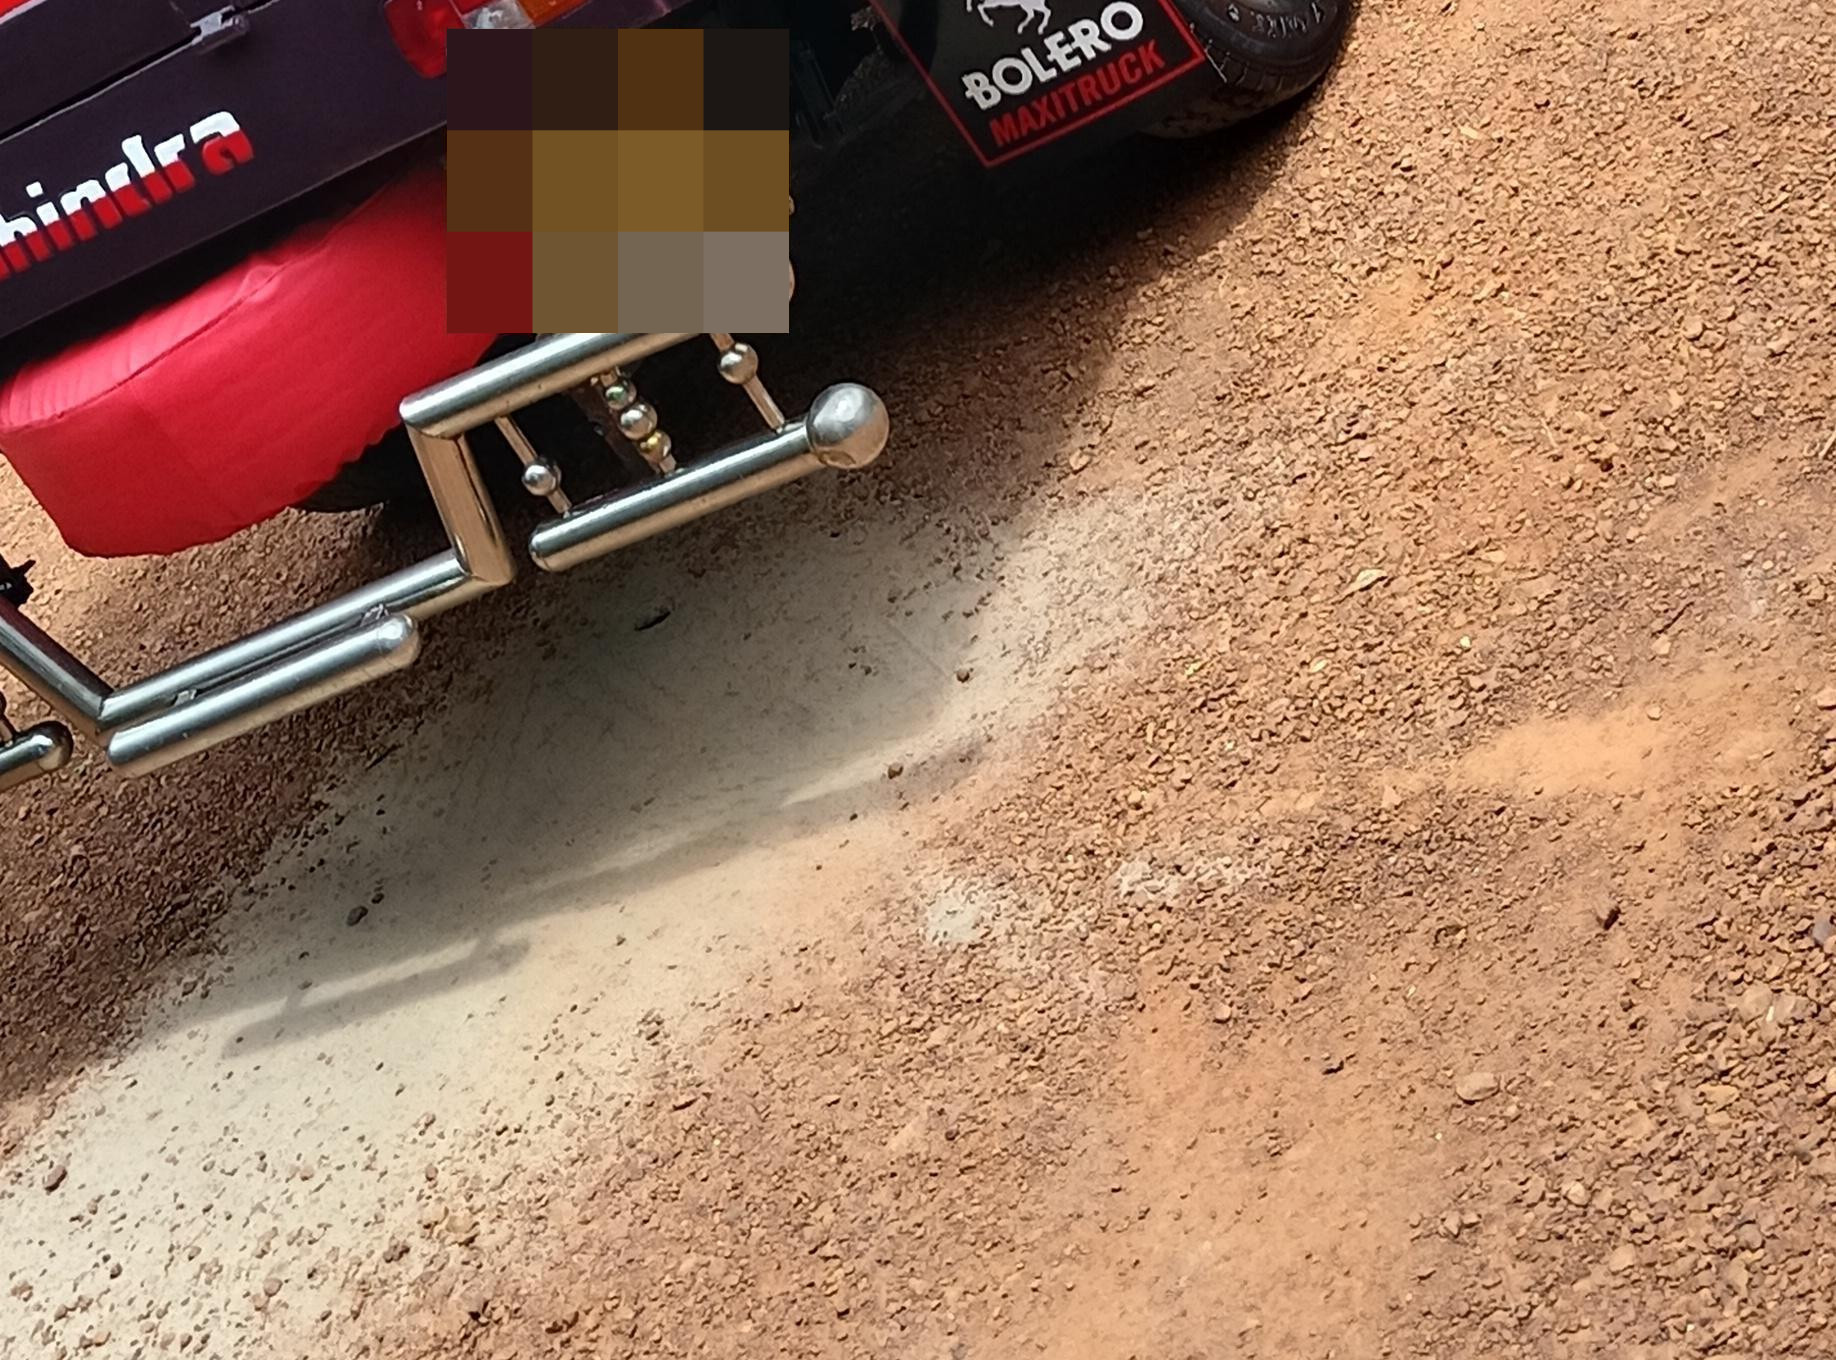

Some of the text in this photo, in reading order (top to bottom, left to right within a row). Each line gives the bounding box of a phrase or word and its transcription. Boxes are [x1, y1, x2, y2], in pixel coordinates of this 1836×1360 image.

[961, 0, 1144, 111] BOLERO
[988, 39, 1166, 147] MAXITRUCK
[0, 110, 254, 280] hindra
